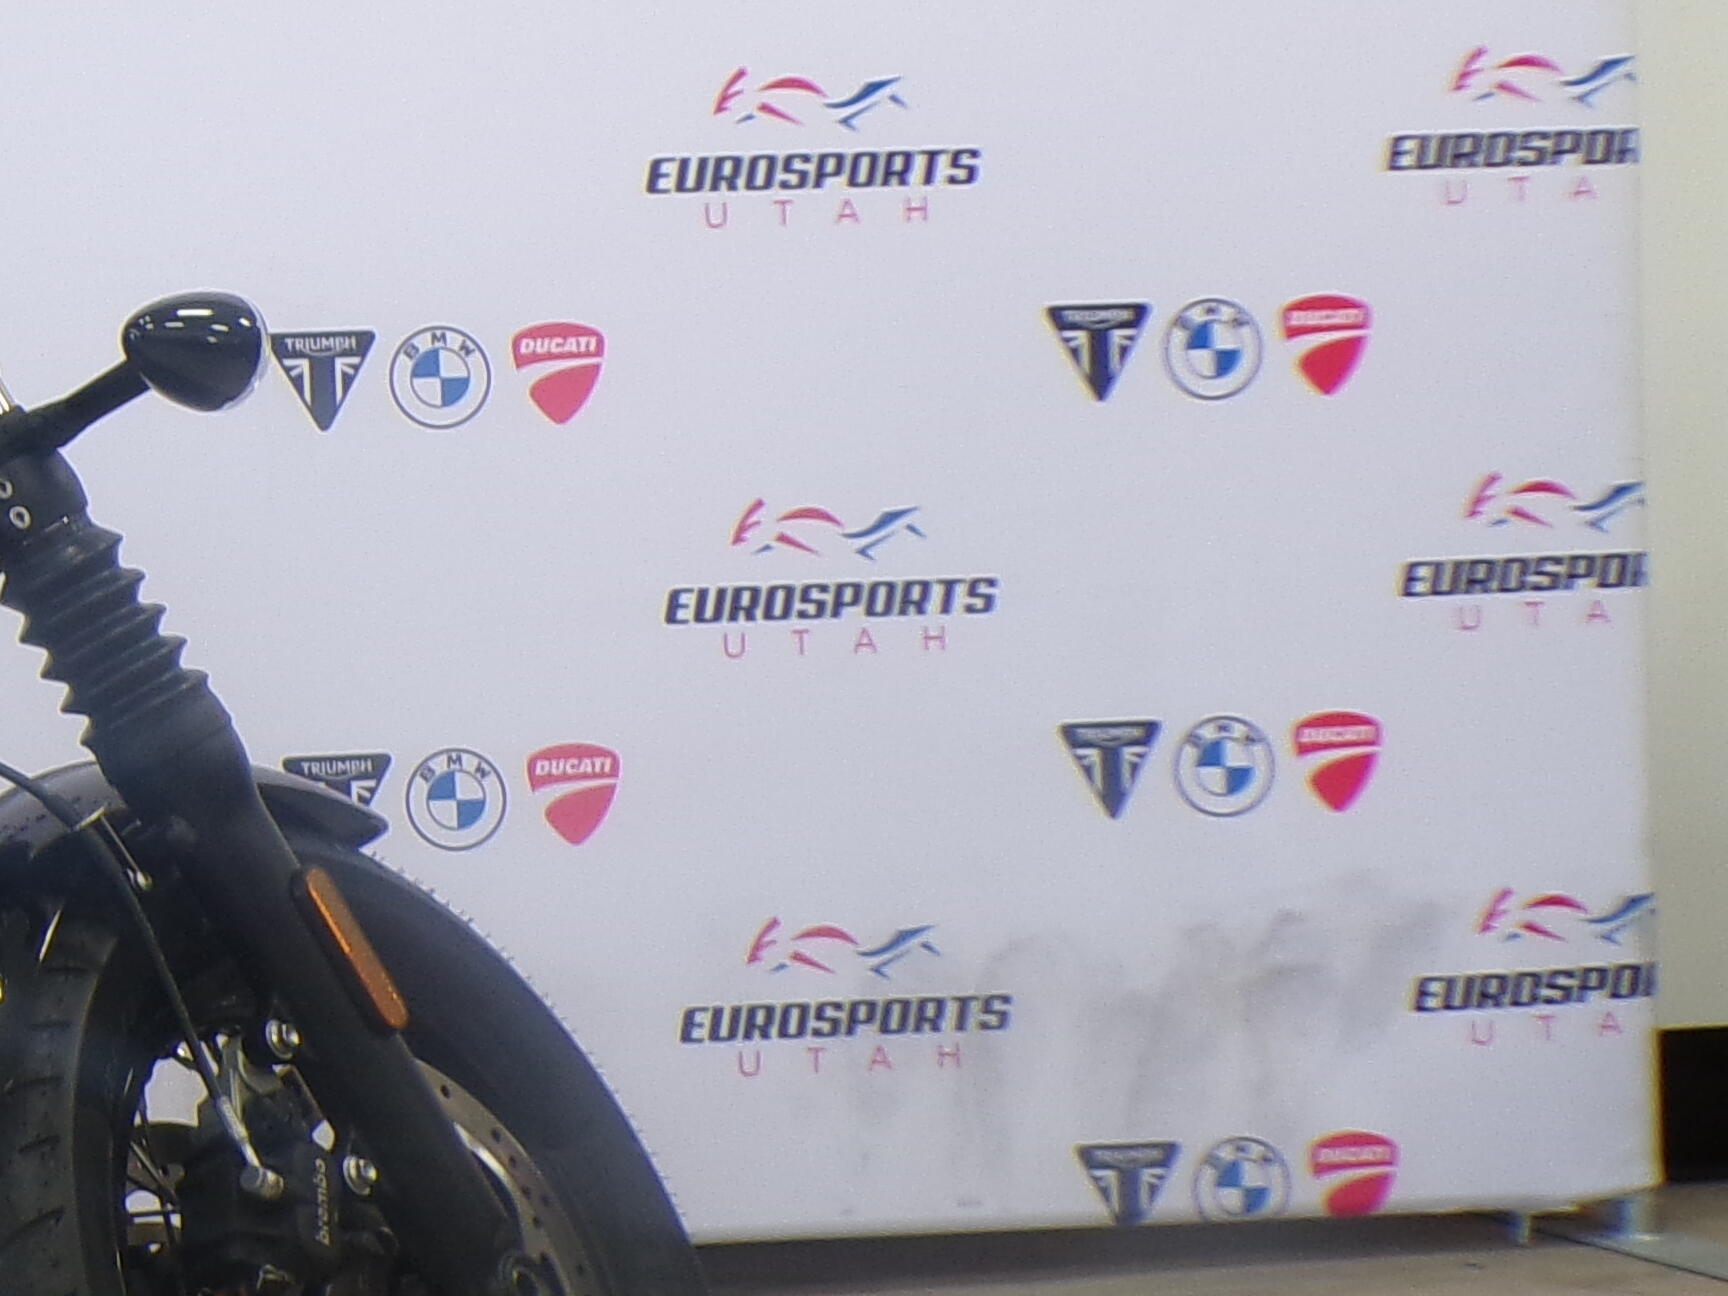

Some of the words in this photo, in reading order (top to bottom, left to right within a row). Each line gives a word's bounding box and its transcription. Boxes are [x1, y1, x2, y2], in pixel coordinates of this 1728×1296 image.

[646, 149, 978, 194] EUROSPORTS
[1444, 176, 1596, 206] UTA
[704, 199, 929, 229] UTAH
[284, 336, 357, 354] TRIUMPH
[404, 331, 475, 362] BMW
[520, 336, 598, 356] DUCATI
[665, 578, 994, 624] EUROSPORTS
[1459, 600, 1609, 632] UTA
[722, 628, 947, 660] UTAH
[300, 758, 373, 777] TRIUMPH
[420, 755, 492, 782] BMW
[535, 757, 611, 776] DUCATI
[680, 994, 1010, 1043] EUROSPORTS
[1470, 1013, 1622, 1046] UTA
[736, 1046, 961, 1079] UTAH
[312, 1157, 331, 1248] brembo
